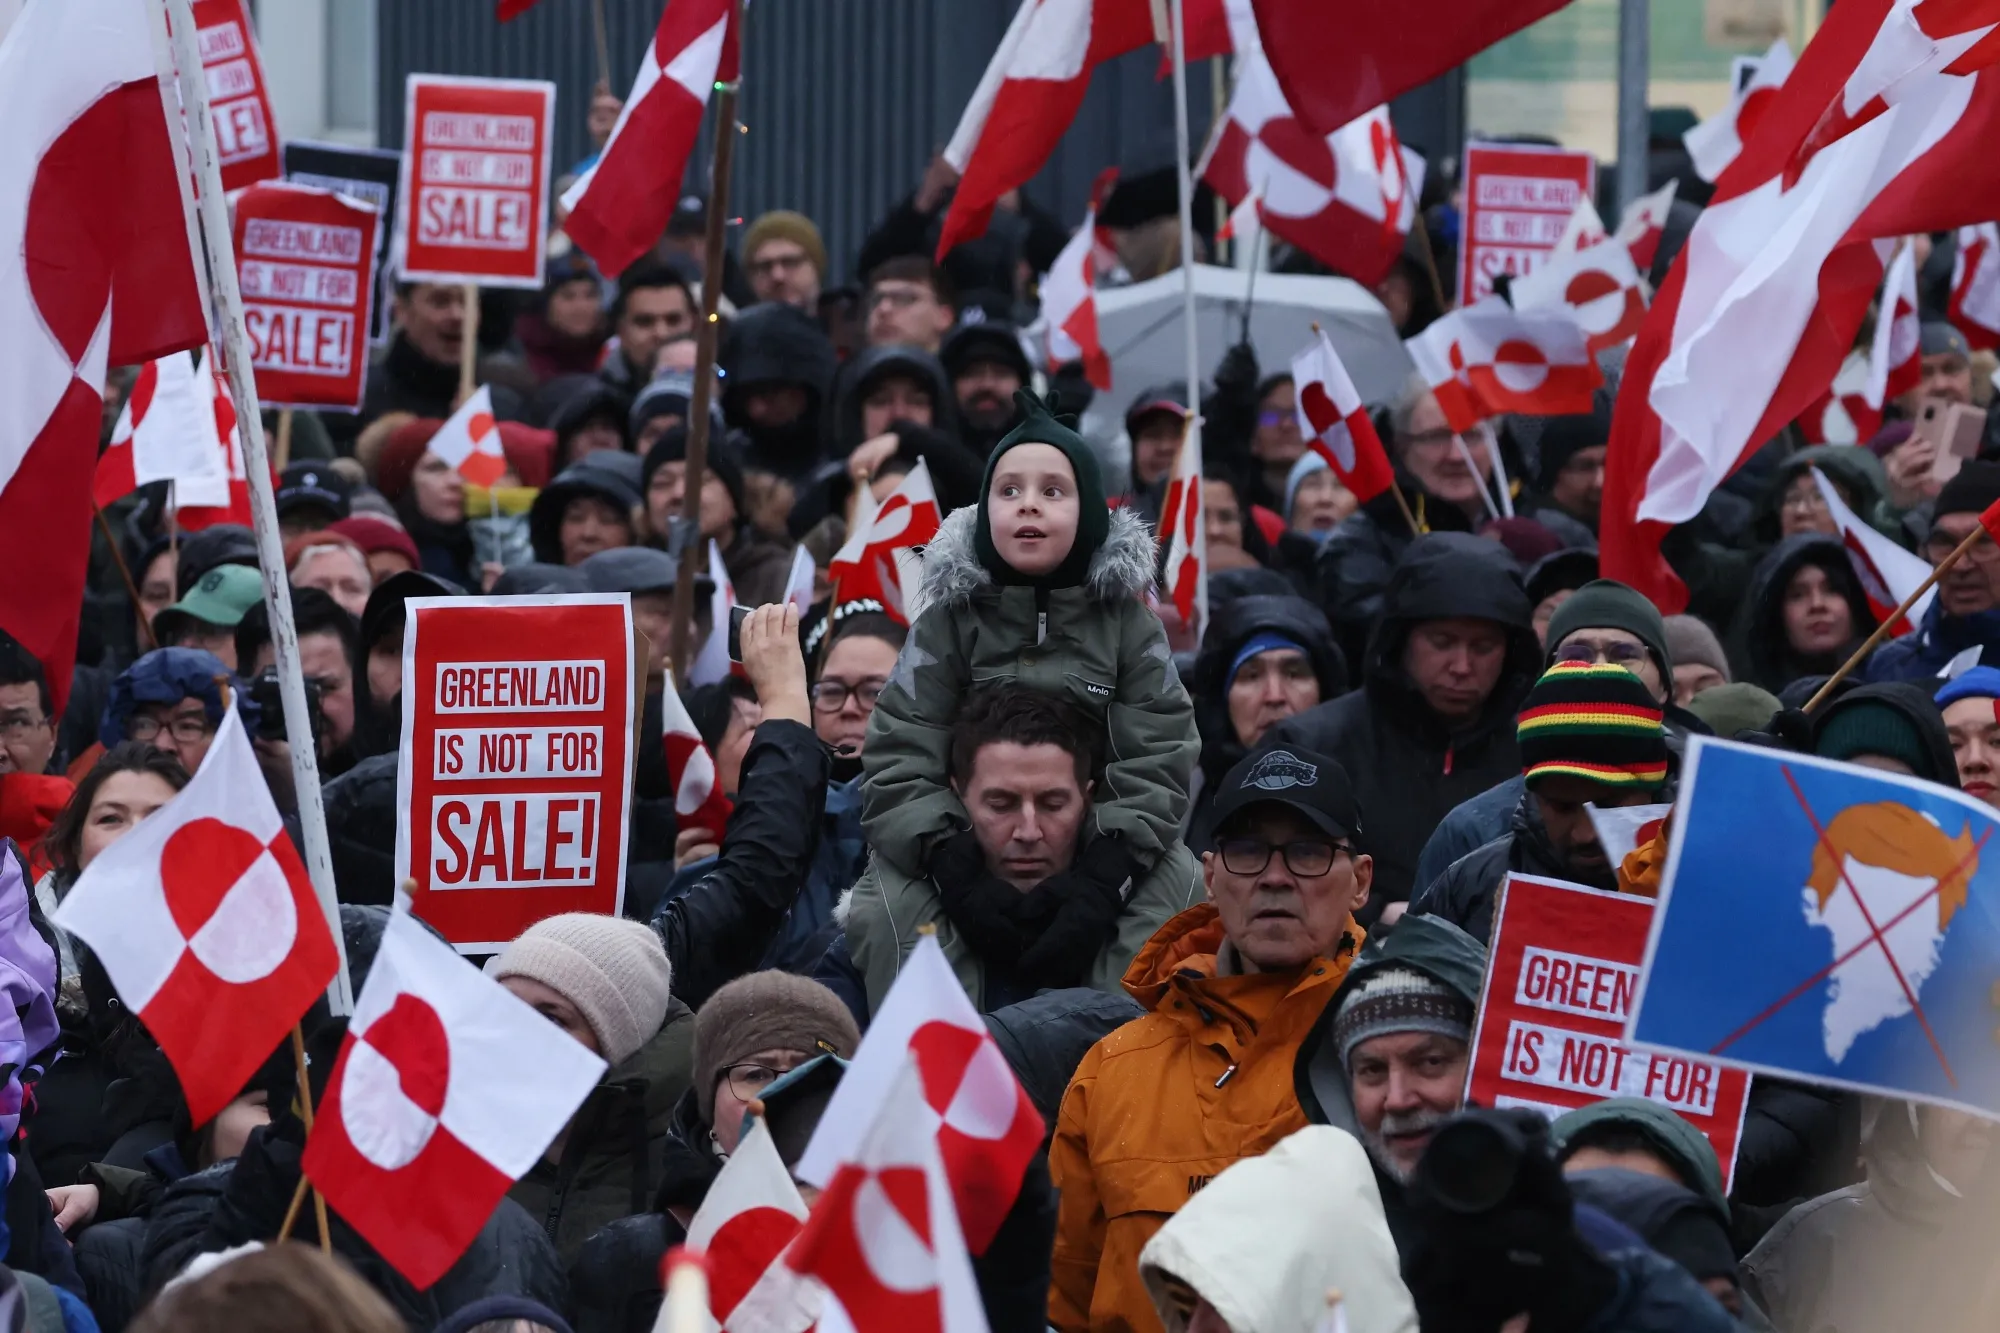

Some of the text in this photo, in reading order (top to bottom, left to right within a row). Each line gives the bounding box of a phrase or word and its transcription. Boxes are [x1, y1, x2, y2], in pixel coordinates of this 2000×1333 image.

[249, 221, 358, 258] GREENLAND
[424, 193, 527, 243] SALE!
[272, 267, 307, 297] NOT
[316, 273, 351, 300] FOR
[245, 309, 349, 371] SALE!
[441, 666, 600, 708] GREENLAND
[439, 732, 597, 774] IS NOT FOR
[436, 798, 596, 885] SALE!
[1524, 954, 1640, 1017] GREEN
[1508, 1027, 1713, 1108] IS NOT FOR
